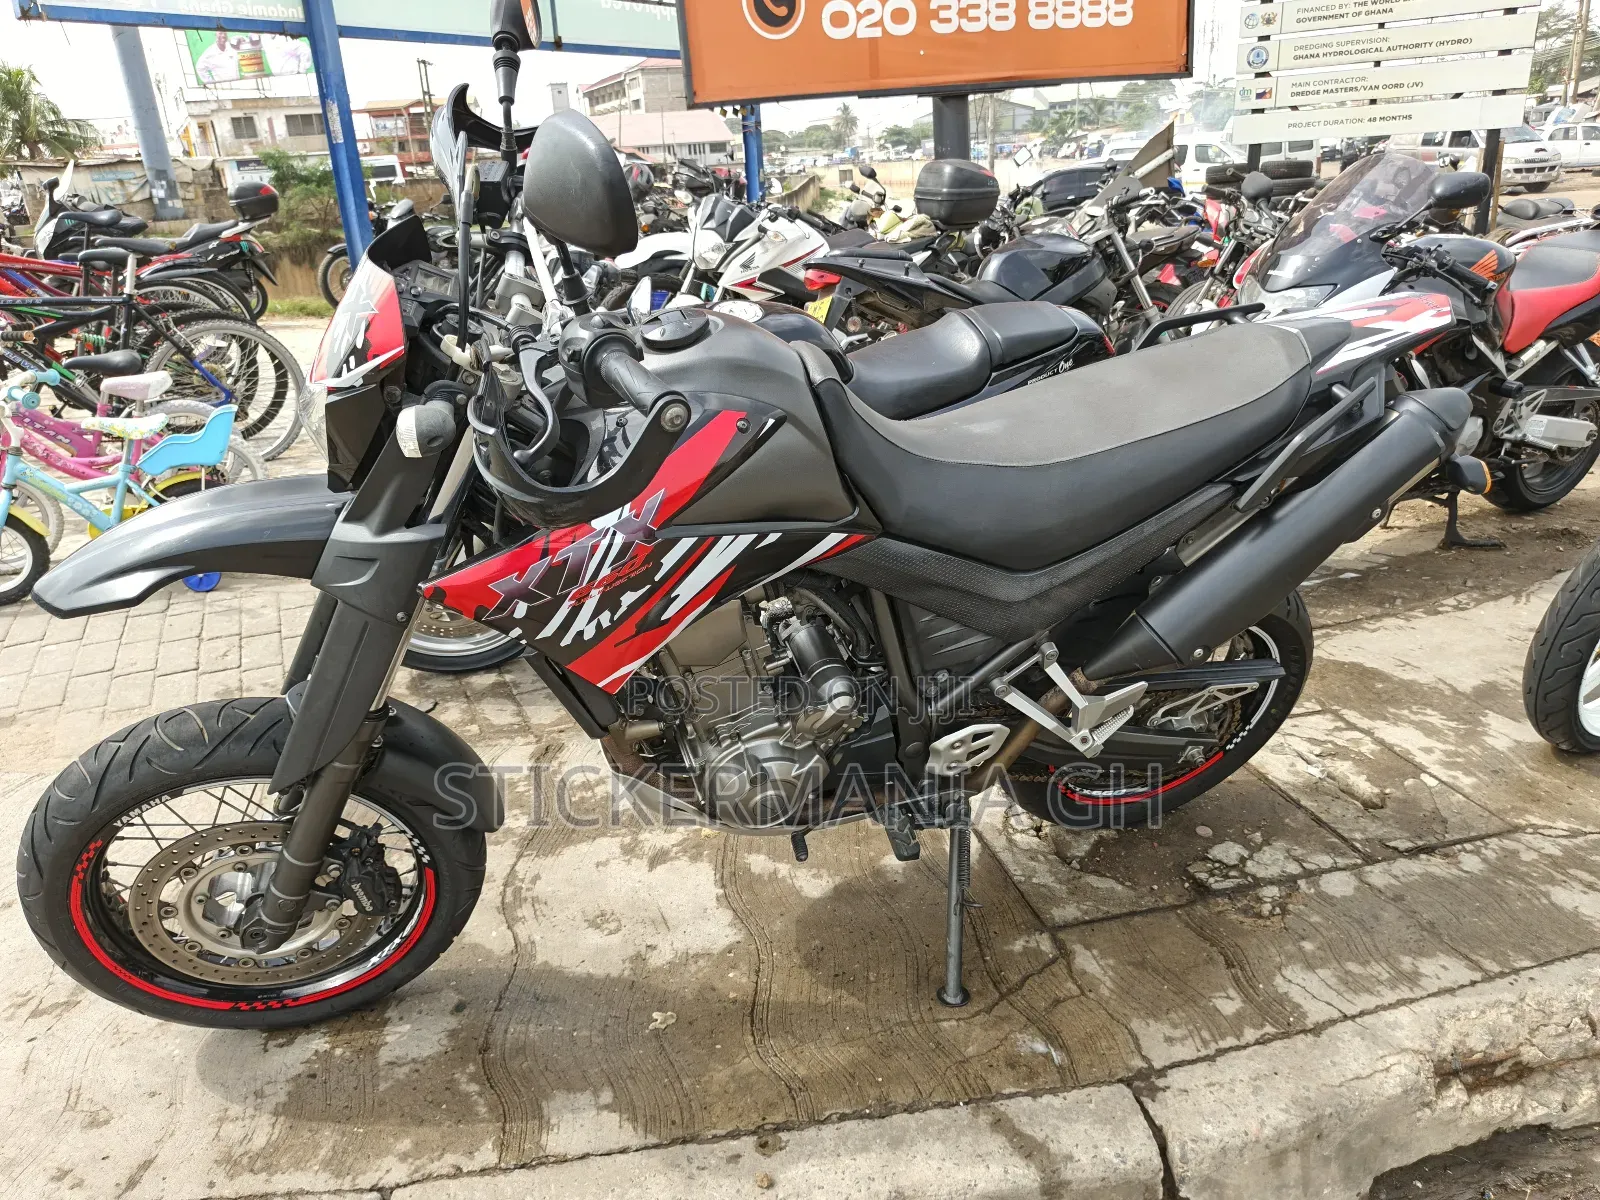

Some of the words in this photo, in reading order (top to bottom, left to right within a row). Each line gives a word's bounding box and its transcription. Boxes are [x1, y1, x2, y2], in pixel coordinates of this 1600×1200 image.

[1296, 4, 1337, 15] FINANCED
[1296, 12, 1350, 24] GOVERNMENT
[1364, 7, 1394, 17] GHANA
[821, 0, 917, 40] 020
[930, 0, 1017, 34] 338
[1027, 0, 1134, 31] 8888
[1292, 53, 1321, 61] GHANA
[1322, 46, 1384, 58] HYDROLOGICAL
[1386, 41, 1434, 52] AUTHORITY
[1435, 37, 1473, 47] (HYDRO)
[1293, 42, 1334, 52] DREDGING
[1335, 36, 1391, 48] SUPERVISION:
[1290, 89, 1321, 98] DREDGE
[1322, 85, 1380, 95] MASTERS/VAN
[1381, 82, 1405, 90] OORD
[1406, 81, 1424, 89] (JV)
[1291, 81, 1311, 89] MAIN
[1312, 76, 1369, 87] CONTRACTOR:
[1287, 120, 1321, 130] PROJECT
[1323, 117, 1366, 127] DURATION:
[1378, 113, 1413, 122] MONTHS
[1027, 368, 1059, 386] PRODUCT
[1058, 358, 1075, 374] One
[112, 794, 172, 828] YAMAHA
[350, 882, 374, 912] brembo
